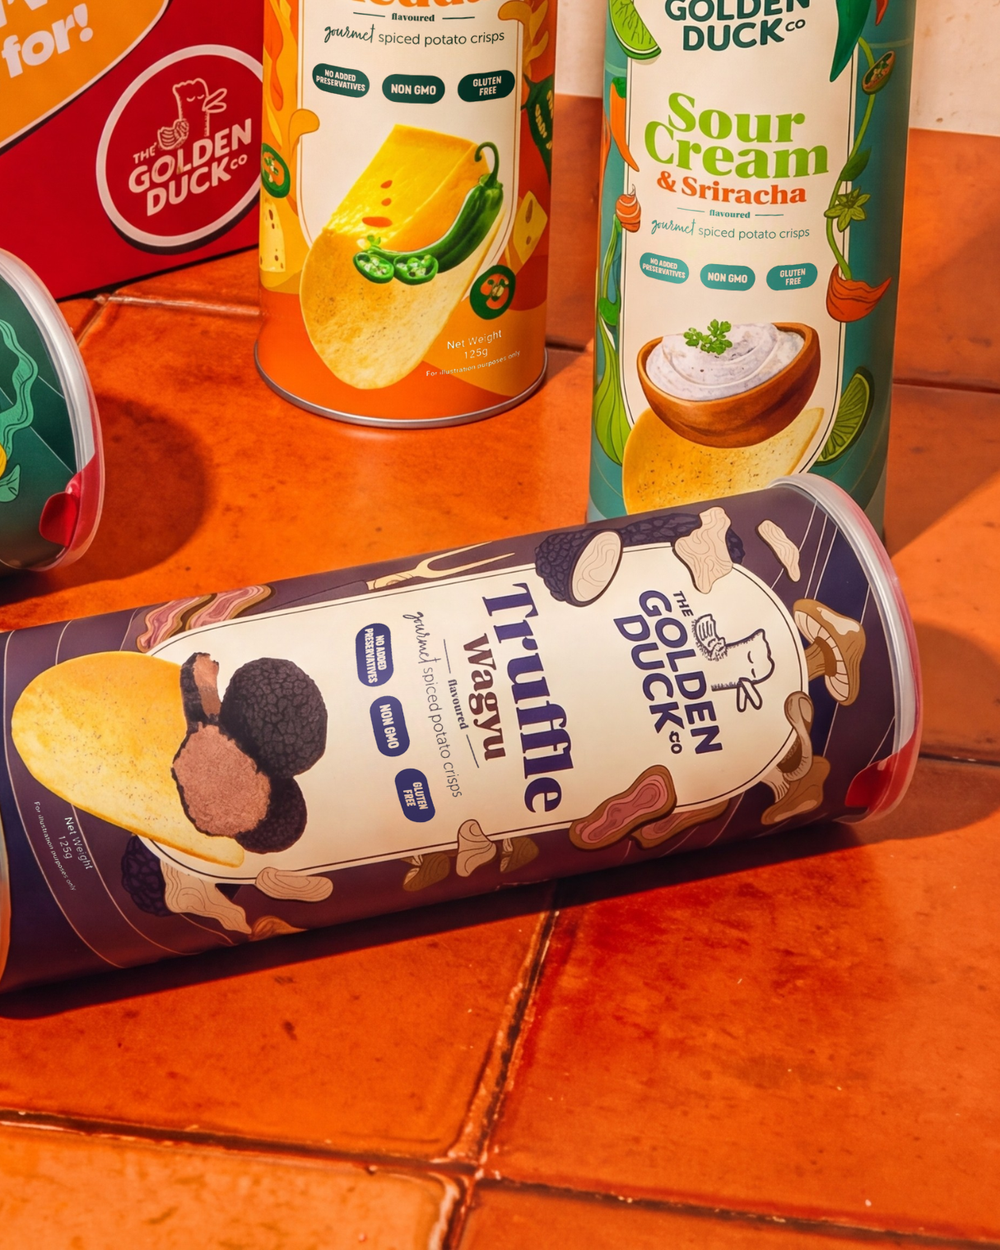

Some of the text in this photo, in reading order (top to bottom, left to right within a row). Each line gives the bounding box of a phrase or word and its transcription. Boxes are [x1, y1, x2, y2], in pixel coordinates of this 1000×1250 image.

[391, 12, 435, 23] flavoured
[0, 2, 95, 91] for!
[324, 23, 505, 47] gourmet spiced potato crisps
[682, 18, 806, 51] DUCK CO
[315, 75, 366, 92] PRESERVATIVES
[324, 69, 357, 82] NO ADDED
[472, 76, 502, 87] GLUTEN
[391, 83, 437, 96] NON GMO
[478, 86, 497, 97] FREE
[667, 92, 806, 144] Sour
[128, 118, 252, 193] GOLDEN
[132, 144, 156, 164] THE
[644, 120, 829, 179] Cream
[147, 154, 248, 217] DUCK CO
[656, 170, 807, 205] & Sriracha
[709, 209, 751, 219] flavoured
[650, 218, 810, 240] gourmet spiced potato crisps
[642, 262, 686, 279] PRESERVATIVES
[650, 257, 678, 270] NO ADDED
[779, 268, 806, 278] GLUTEN
[707, 272, 748, 284] NON GMO
[785, 276, 802, 286] FREE
[447, 329, 502, 350] Net Weight
[439, 365, 476, 376] illustration
[477, 357, 507, 369] purposes
[507, 350, 521, 360] only
[464, 348, 488, 359] 125g
[672, 590, 694, 617] THE
[364, 628, 378, 684] PRESERVATIVES
[375, 634, 387, 671] NO ADDED
[612, 615, 685, 734] DUCK
[638, 589, 724, 755] GOLDEN
[402, 611, 463, 798] gourmet spiced potato crisps
[447, 679, 469, 730] flavoured
[462, 633, 506, 762] Wagyu
[481, 582, 575, 814] Truffle
[379, 703, 400, 750] NON GMO
[402, 789, 416, 808] FREE
[412, 781, 429, 811] GLUTEN
[58, 835, 73, 859] 125g
[64, 816, 93, 870] Net Weight
[50, 850, 68, 879] purposes
[65, 879, 77, 891] only
